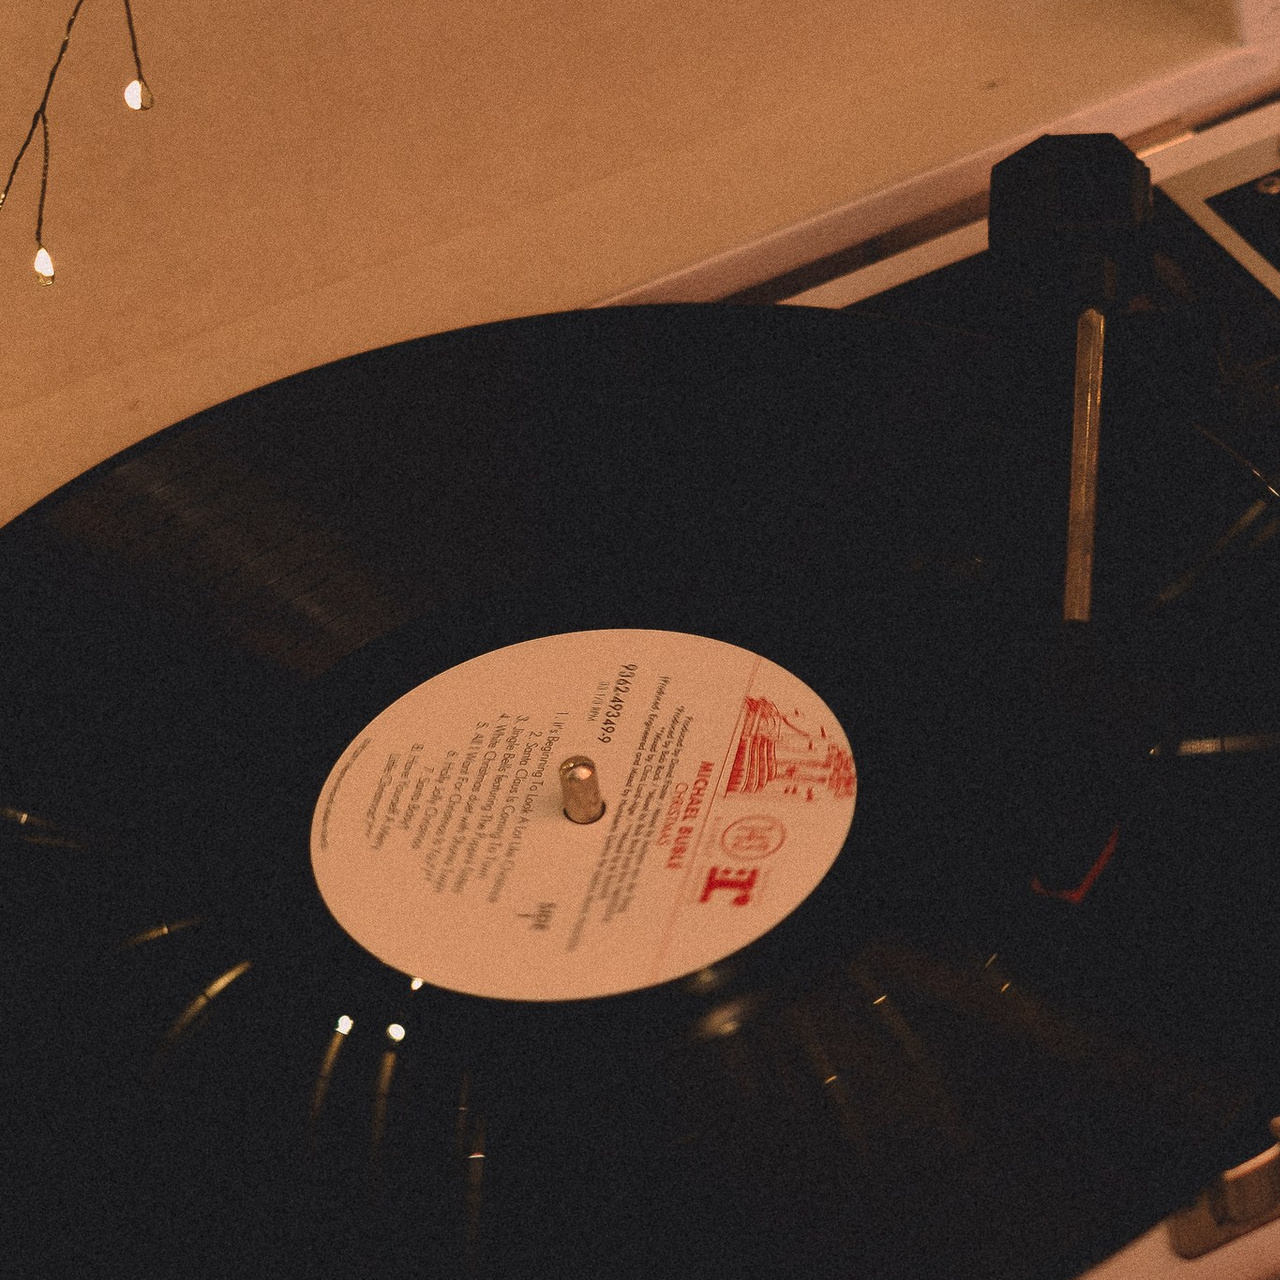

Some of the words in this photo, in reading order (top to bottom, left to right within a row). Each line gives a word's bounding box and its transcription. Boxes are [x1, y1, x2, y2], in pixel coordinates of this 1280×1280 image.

[597, 663, 637, 743] 9362-49349-9
[469, 732, 484, 744] All
[487, 724, 507, 748] White
[505, 726, 524, 750] Jingle
[459, 751, 478, 774] Want
[496, 752, 516, 772] Bells
[518, 742, 538, 766] Santa
[530, 735, 560, 777] Beginning
[632, 751, 642, 766] and
[471, 750, 497, 792] Christmas
[508, 767, 528, 793] Claus
[453, 776, 469, 791] For
[480, 774, 508, 811] featuring
[682, 760, 713, 820] MICHAEL
[520, 793, 538, 813] Look
[656, 782, 688, 845] CHRISTMAS
[489, 804, 515, 839] Coming
[511, 825, 527, 839] Lot
